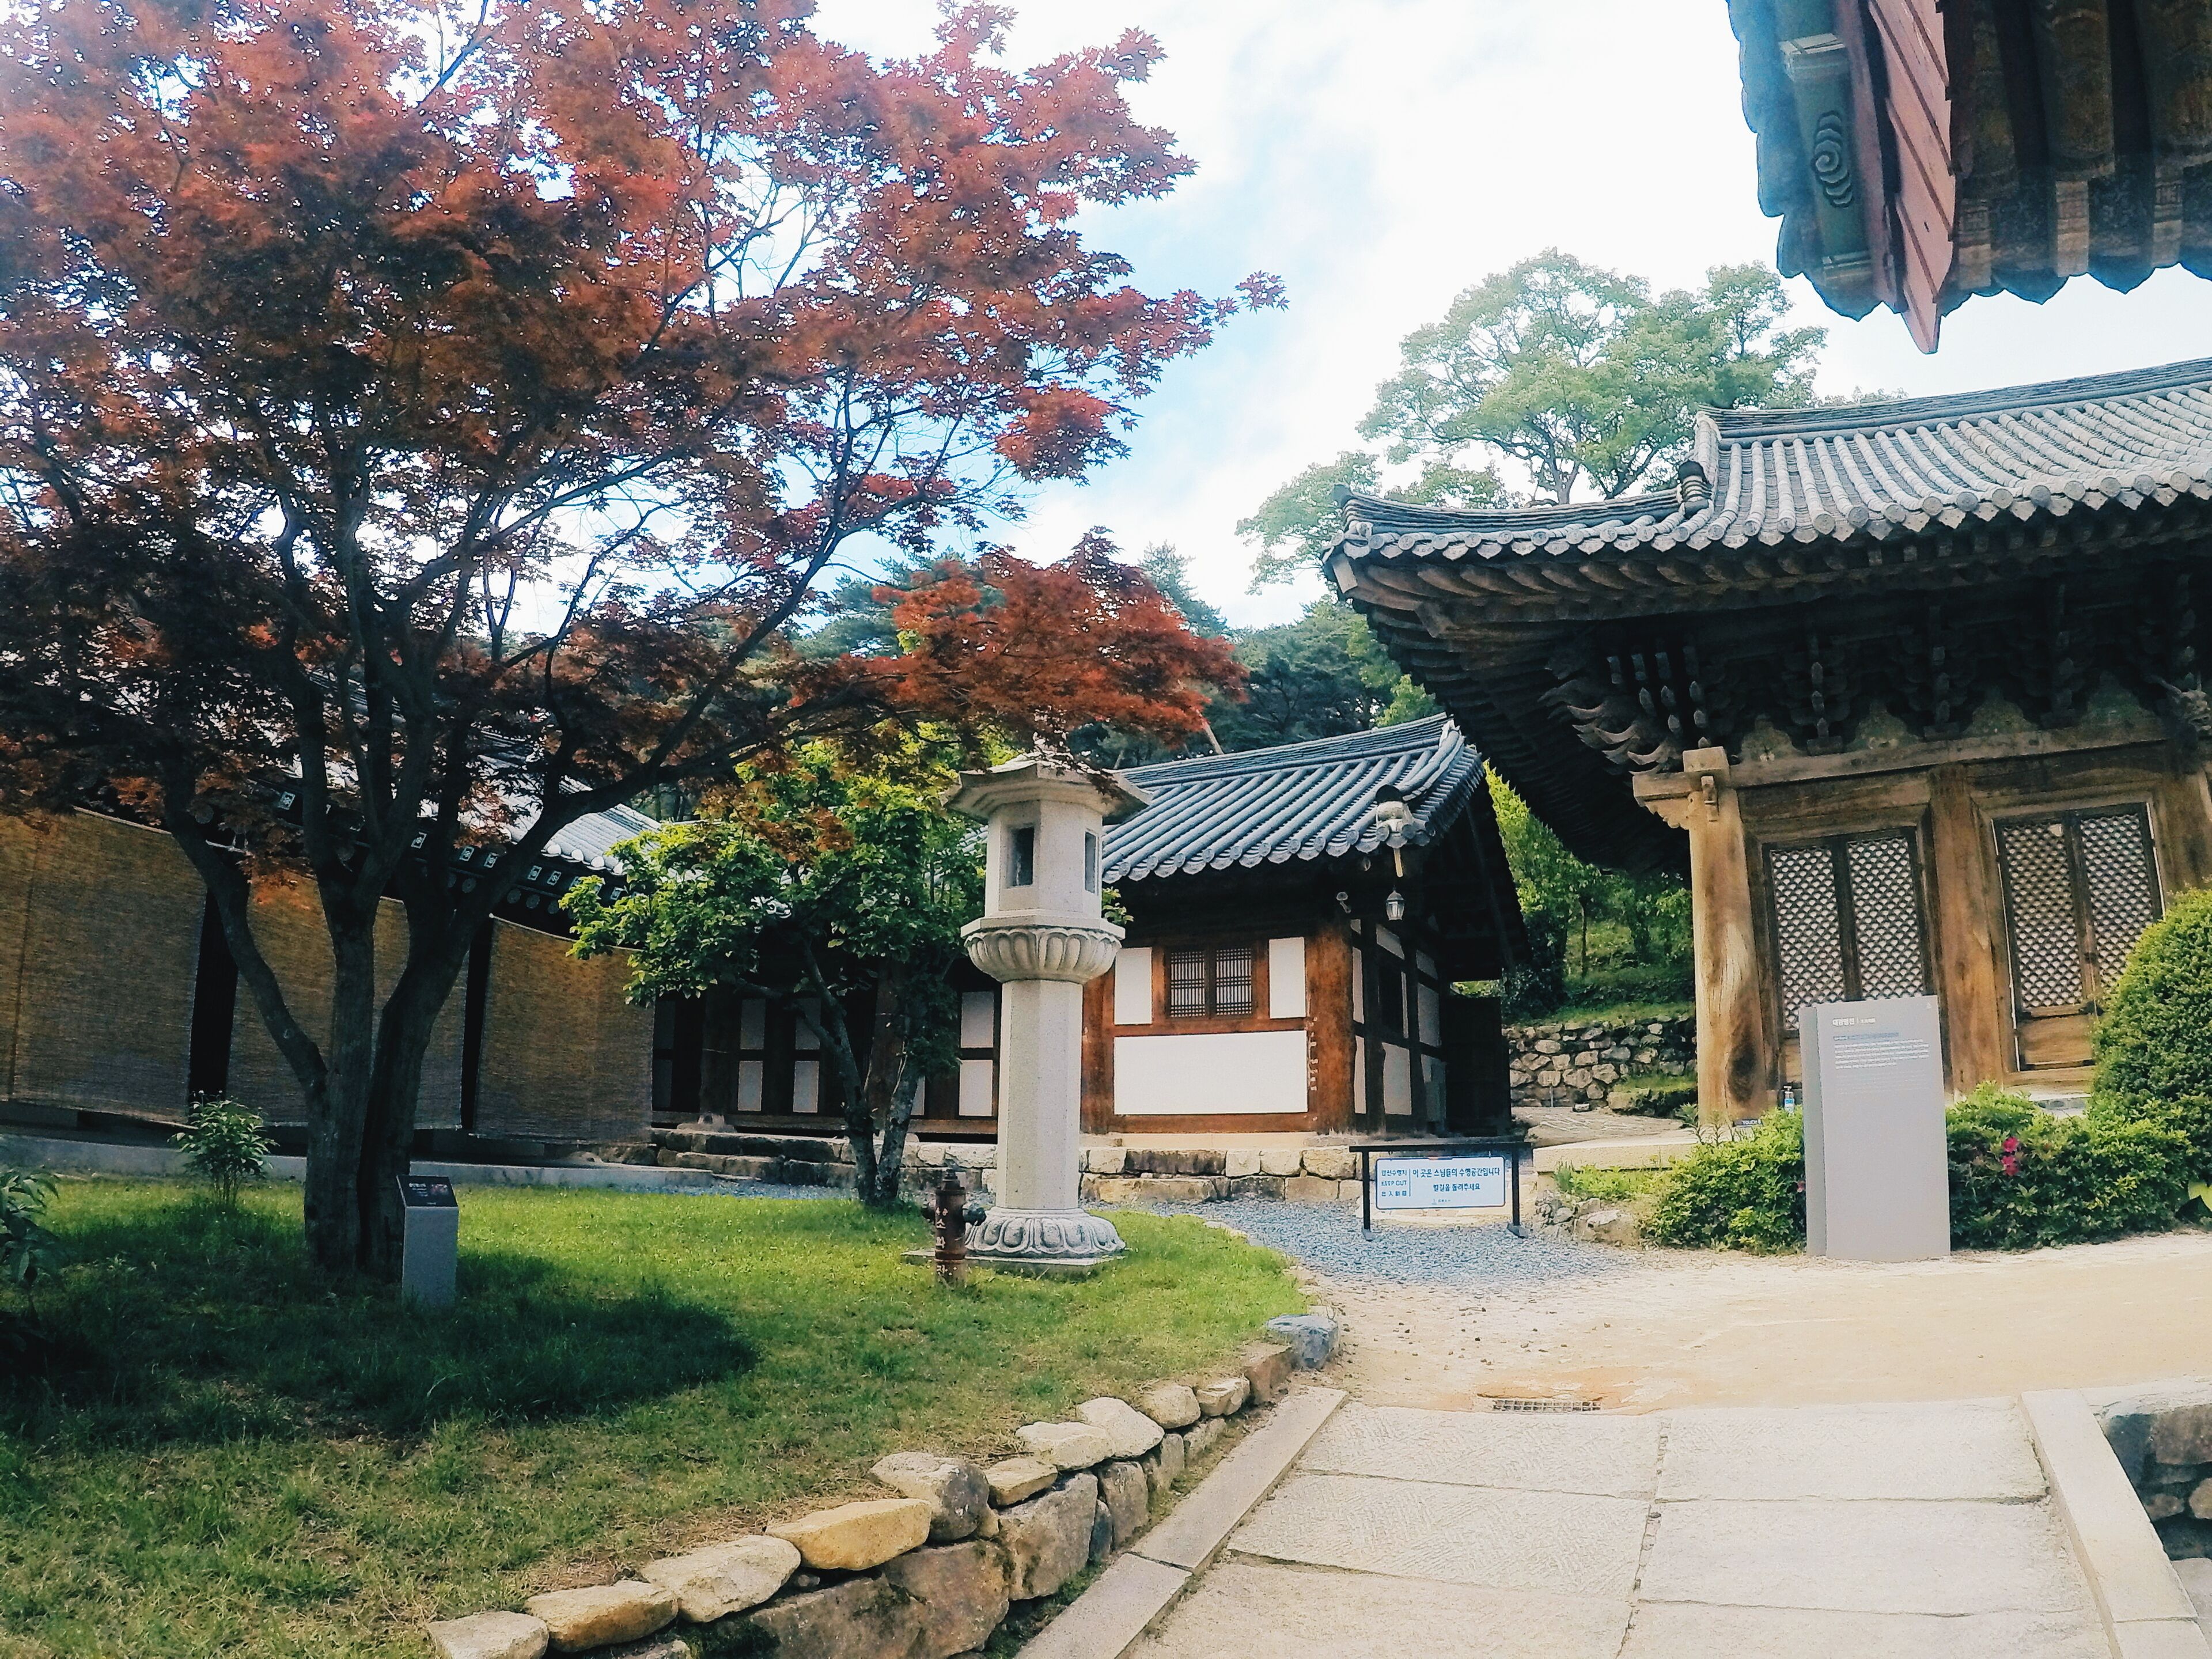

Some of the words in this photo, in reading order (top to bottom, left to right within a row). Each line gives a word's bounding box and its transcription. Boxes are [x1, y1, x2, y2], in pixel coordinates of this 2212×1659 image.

[1412, 1169, 1419, 1178] 이
[1421, 1169, 1432, 1178] 곳은
[1434, 1168, 1457, 1177] 스님들의
[1459, 1167, 1500, 1177] 수행공간입니다
